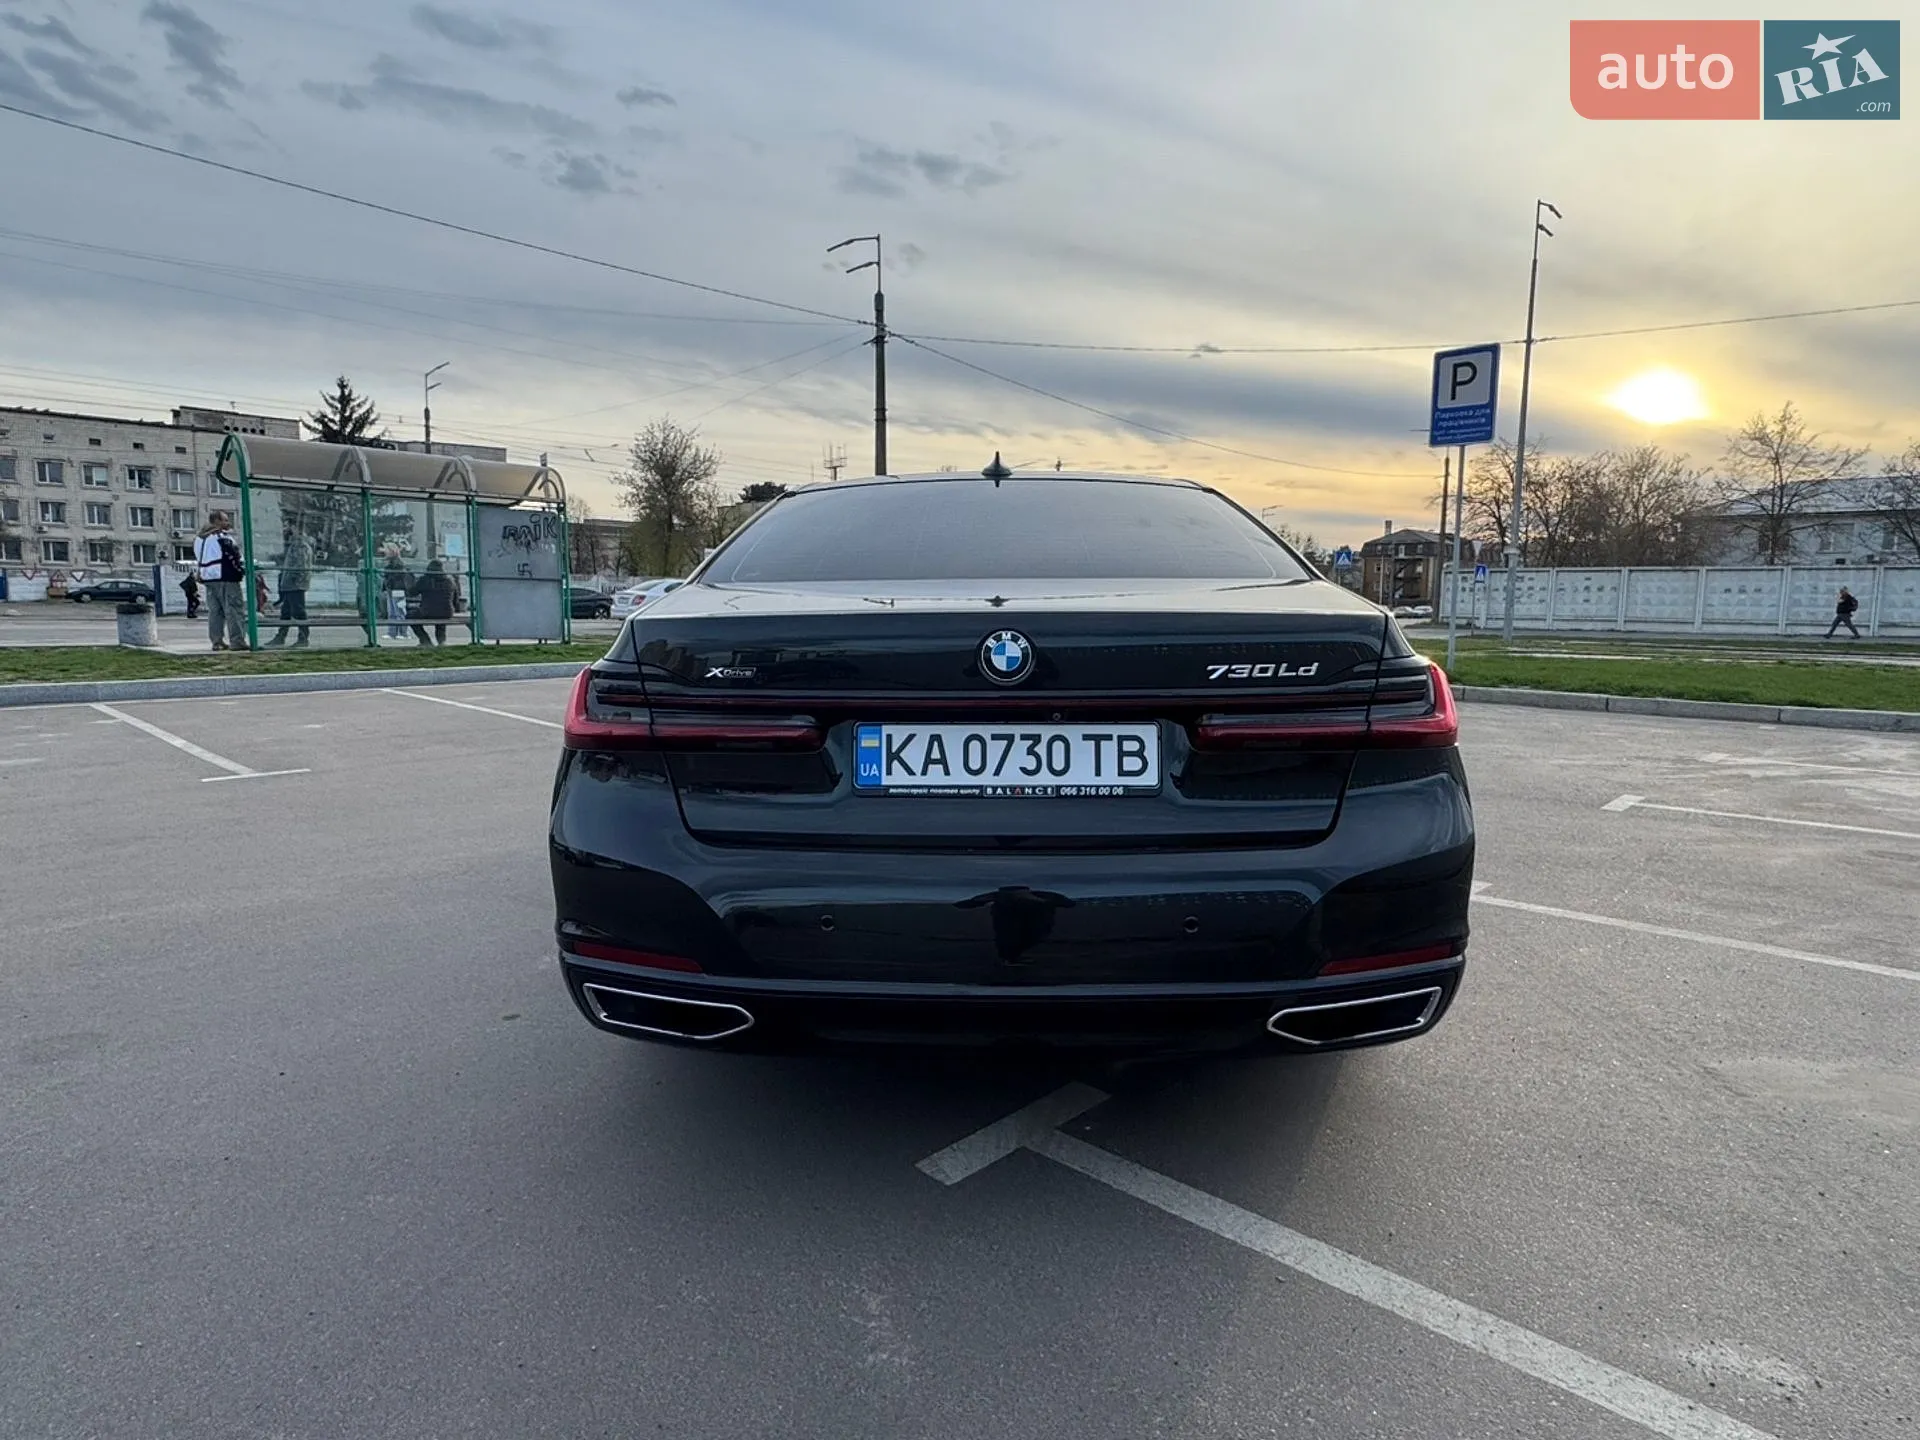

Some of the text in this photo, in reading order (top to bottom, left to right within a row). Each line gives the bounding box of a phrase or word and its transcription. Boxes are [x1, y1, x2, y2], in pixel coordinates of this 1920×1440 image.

[1451, 361, 1478, 400] P
[986, 631, 1027, 648] BMW
[1206, 662, 1319, 680] 730Ld
[885, 733, 1149, 777] KA 0730 TB
[860, 763, 880, 777] UA
